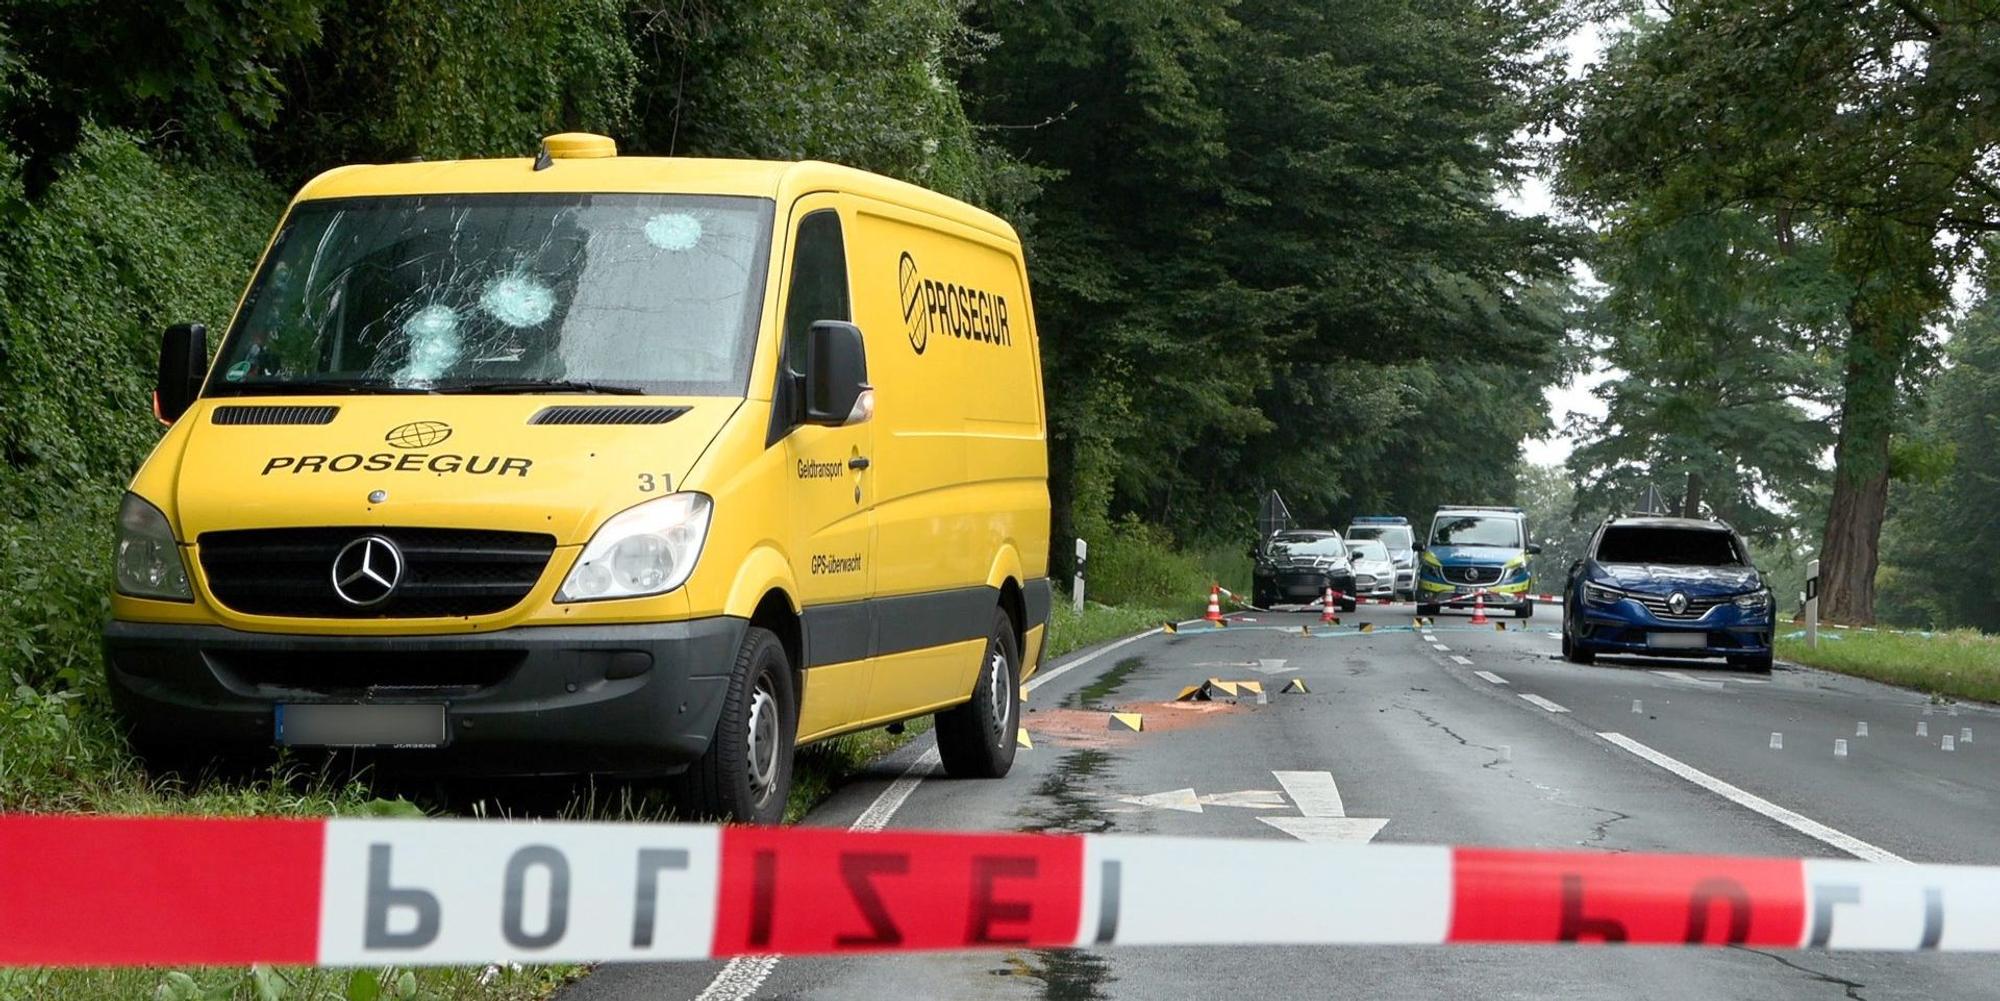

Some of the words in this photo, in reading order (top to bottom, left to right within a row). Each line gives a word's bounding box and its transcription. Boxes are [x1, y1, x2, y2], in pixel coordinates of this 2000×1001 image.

[923, 278, 1011, 347] PROSEGUR
[261, 453, 534, 477] PROSEGUR
[797, 458, 843, 482] Geldtransport
[637, 473, 673, 493] 31
[811, 552, 862, 575] GPS-überwacht
